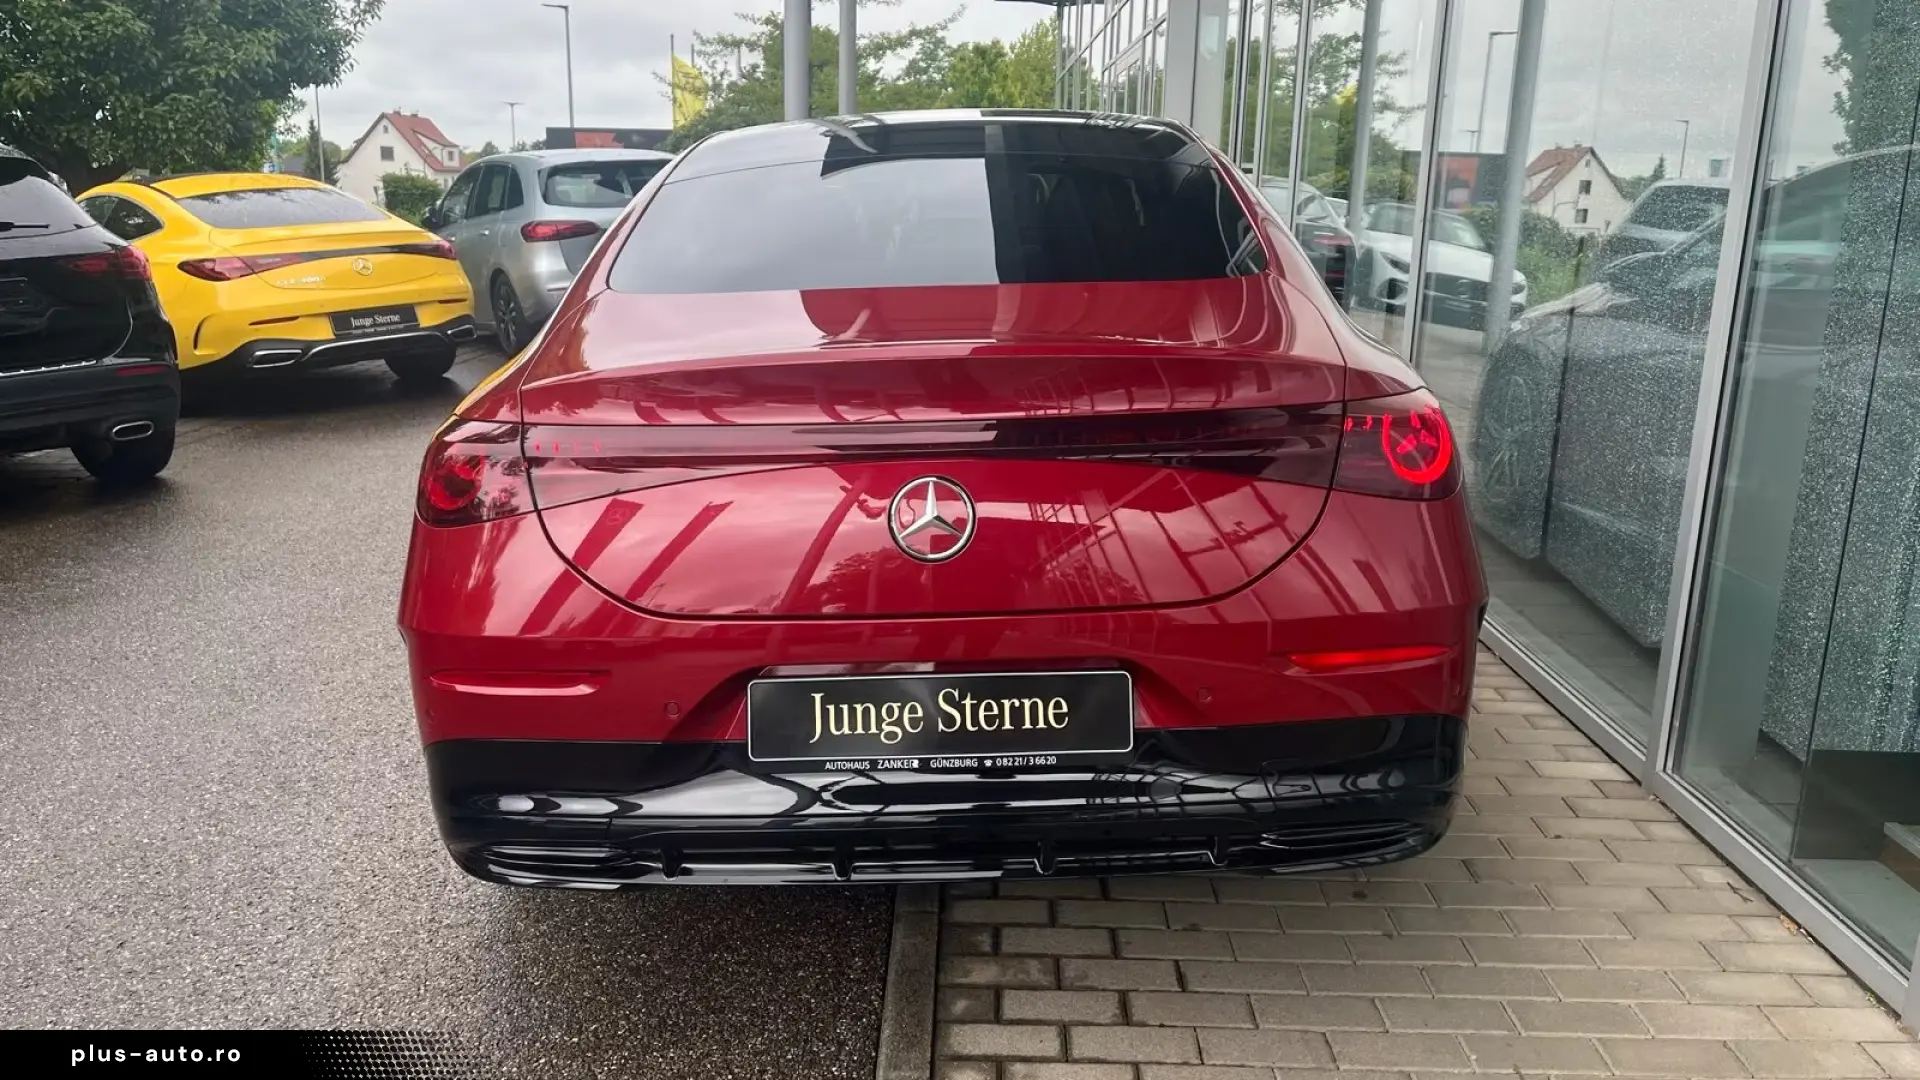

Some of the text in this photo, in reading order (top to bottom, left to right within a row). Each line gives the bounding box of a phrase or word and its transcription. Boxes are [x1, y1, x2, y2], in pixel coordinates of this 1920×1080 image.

[350, 313, 401, 328] Junge Sterne
[809, 687, 1069, 744] Junge Sterne
[824, 760, 871, 770] AUTOHAUS
[929, 758, 978, 768] GÜNZBURG
